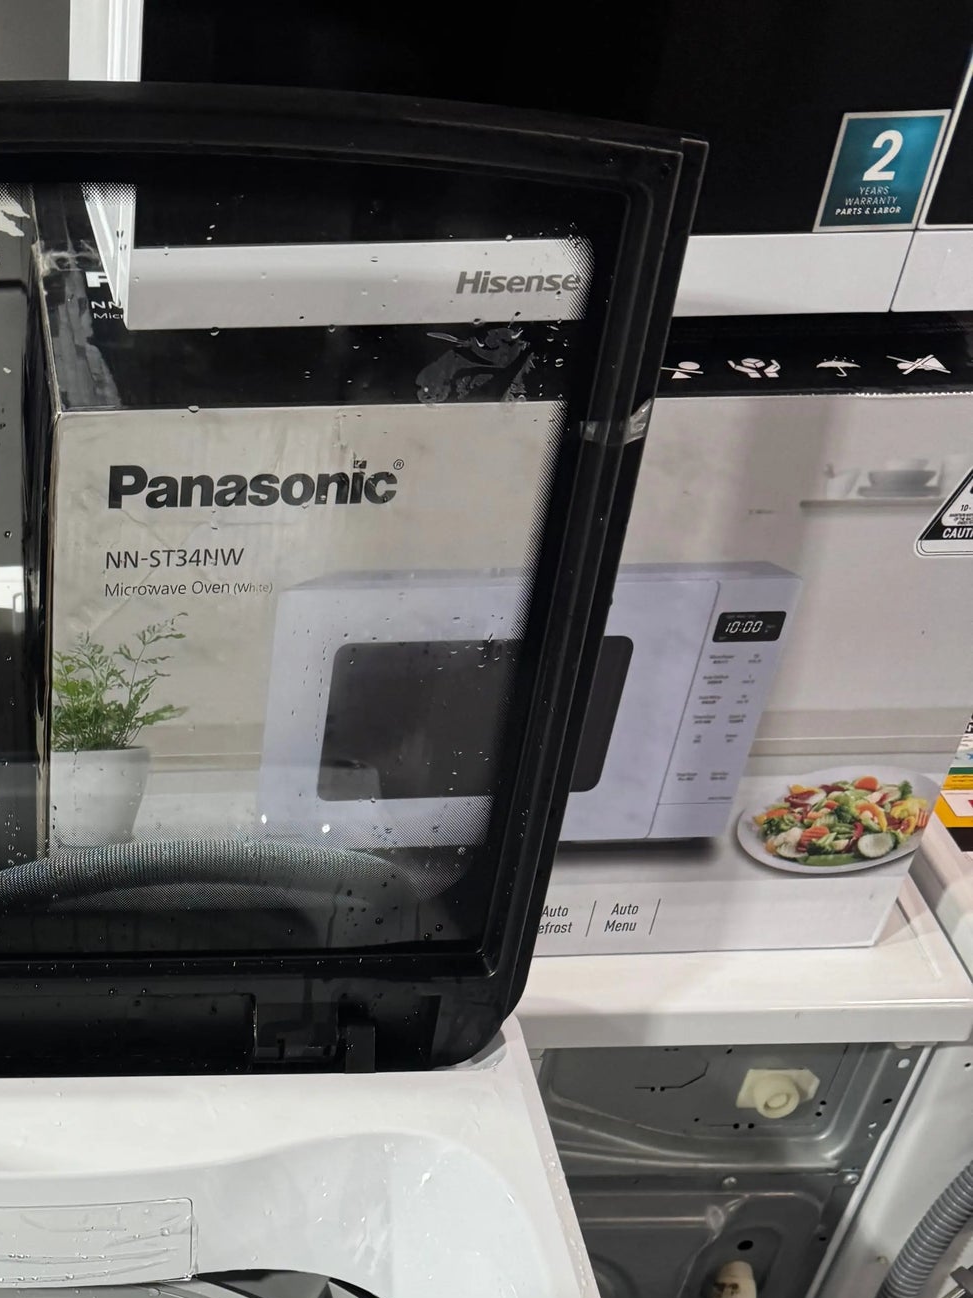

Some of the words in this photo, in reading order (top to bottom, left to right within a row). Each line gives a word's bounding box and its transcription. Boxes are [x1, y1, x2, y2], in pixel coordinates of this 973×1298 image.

[863, 130, 903, 180] 2
[859, 186, 889, 195] YEARS
[845, 196, 897, 205] WARRANTY
[873, 206, 902, 214] LABOR
[456, 270, 581, 294] Hisense
[109, 460, 397, 509] Panasonic
[106, 548, 244, 569] NN-ST34NW
[105, 582, 186, 597] Microwave
[192, 581, 229, 595] Oven
[725, 621, 762, 633] 10:00
[541, 905, 569, 917] Auto
[611, 903, 639, 916] Auto
[538, 922, 573, 934] efrost
[604, 920, 637, 932] Menu
